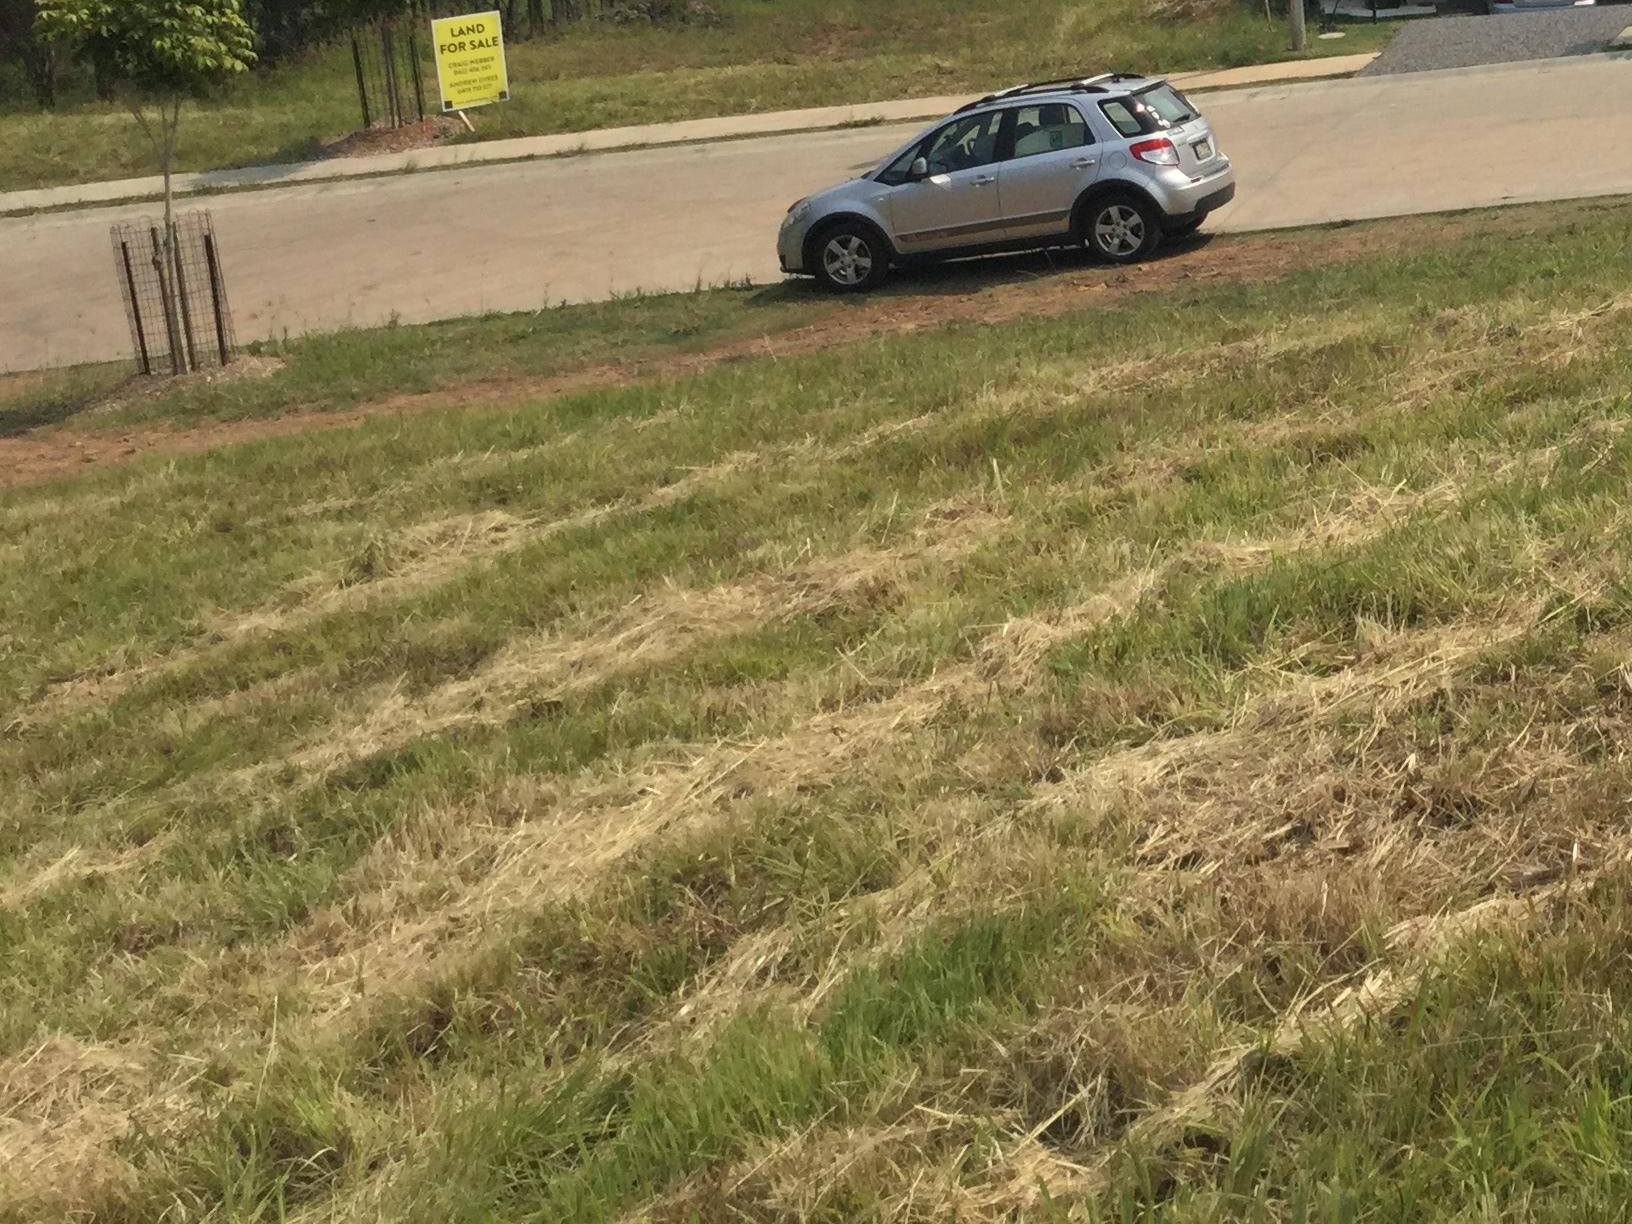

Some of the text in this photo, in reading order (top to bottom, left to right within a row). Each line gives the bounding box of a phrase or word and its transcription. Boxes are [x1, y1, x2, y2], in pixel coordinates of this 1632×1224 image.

[451, 24, 485, 37] LAND
[440, 37, 498, 54] FOR SALE
